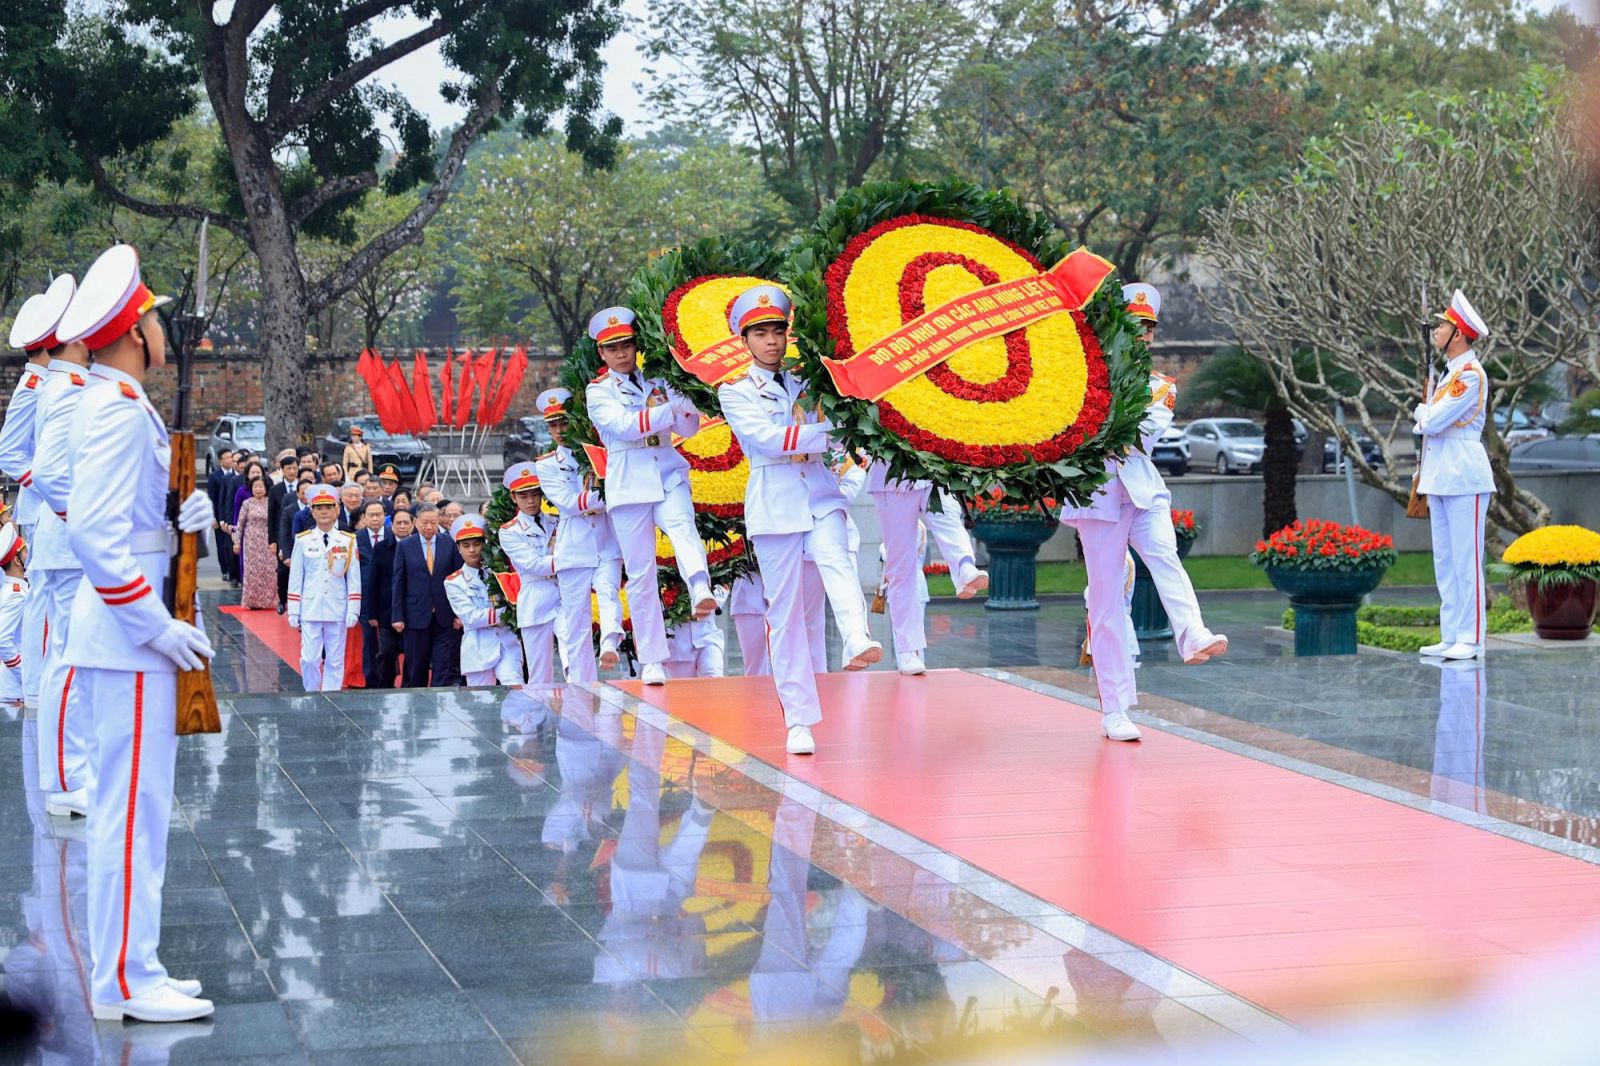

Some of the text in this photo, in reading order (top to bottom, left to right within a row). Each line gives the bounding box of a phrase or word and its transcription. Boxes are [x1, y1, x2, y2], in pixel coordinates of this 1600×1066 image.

[867, 347, 895, 366] ĐỜI
[887, 336, 915, 355] ĐỜI
[907, 322, 938, 344] NHỚ
[949, 303, 977, 321] CÁC
[971, 295, 999, 313] ANH
[894, 359, 915, 373] BAN
[946, 326, 974, 343] TRUNG
